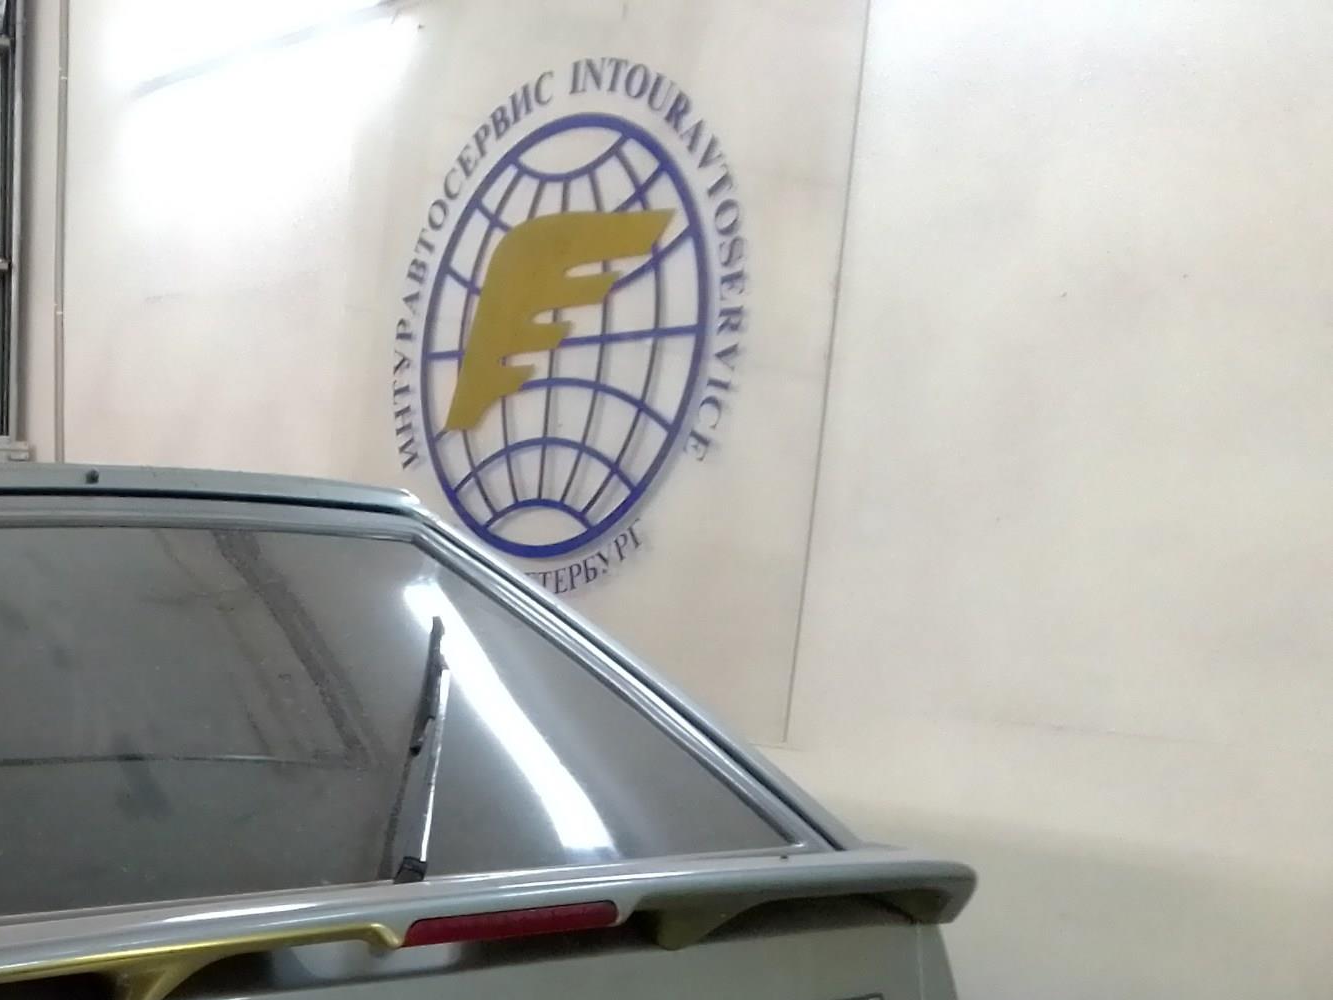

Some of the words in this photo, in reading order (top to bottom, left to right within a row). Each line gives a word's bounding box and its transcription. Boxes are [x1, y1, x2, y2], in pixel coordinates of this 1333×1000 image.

[393, 70, 554, 470] ИНТУРАВТОСЕРВИС
[569, 56, 746, 463] INTOURAVTOSERVICE
[525, 518, 643, 594] ТЕРБУРГ
